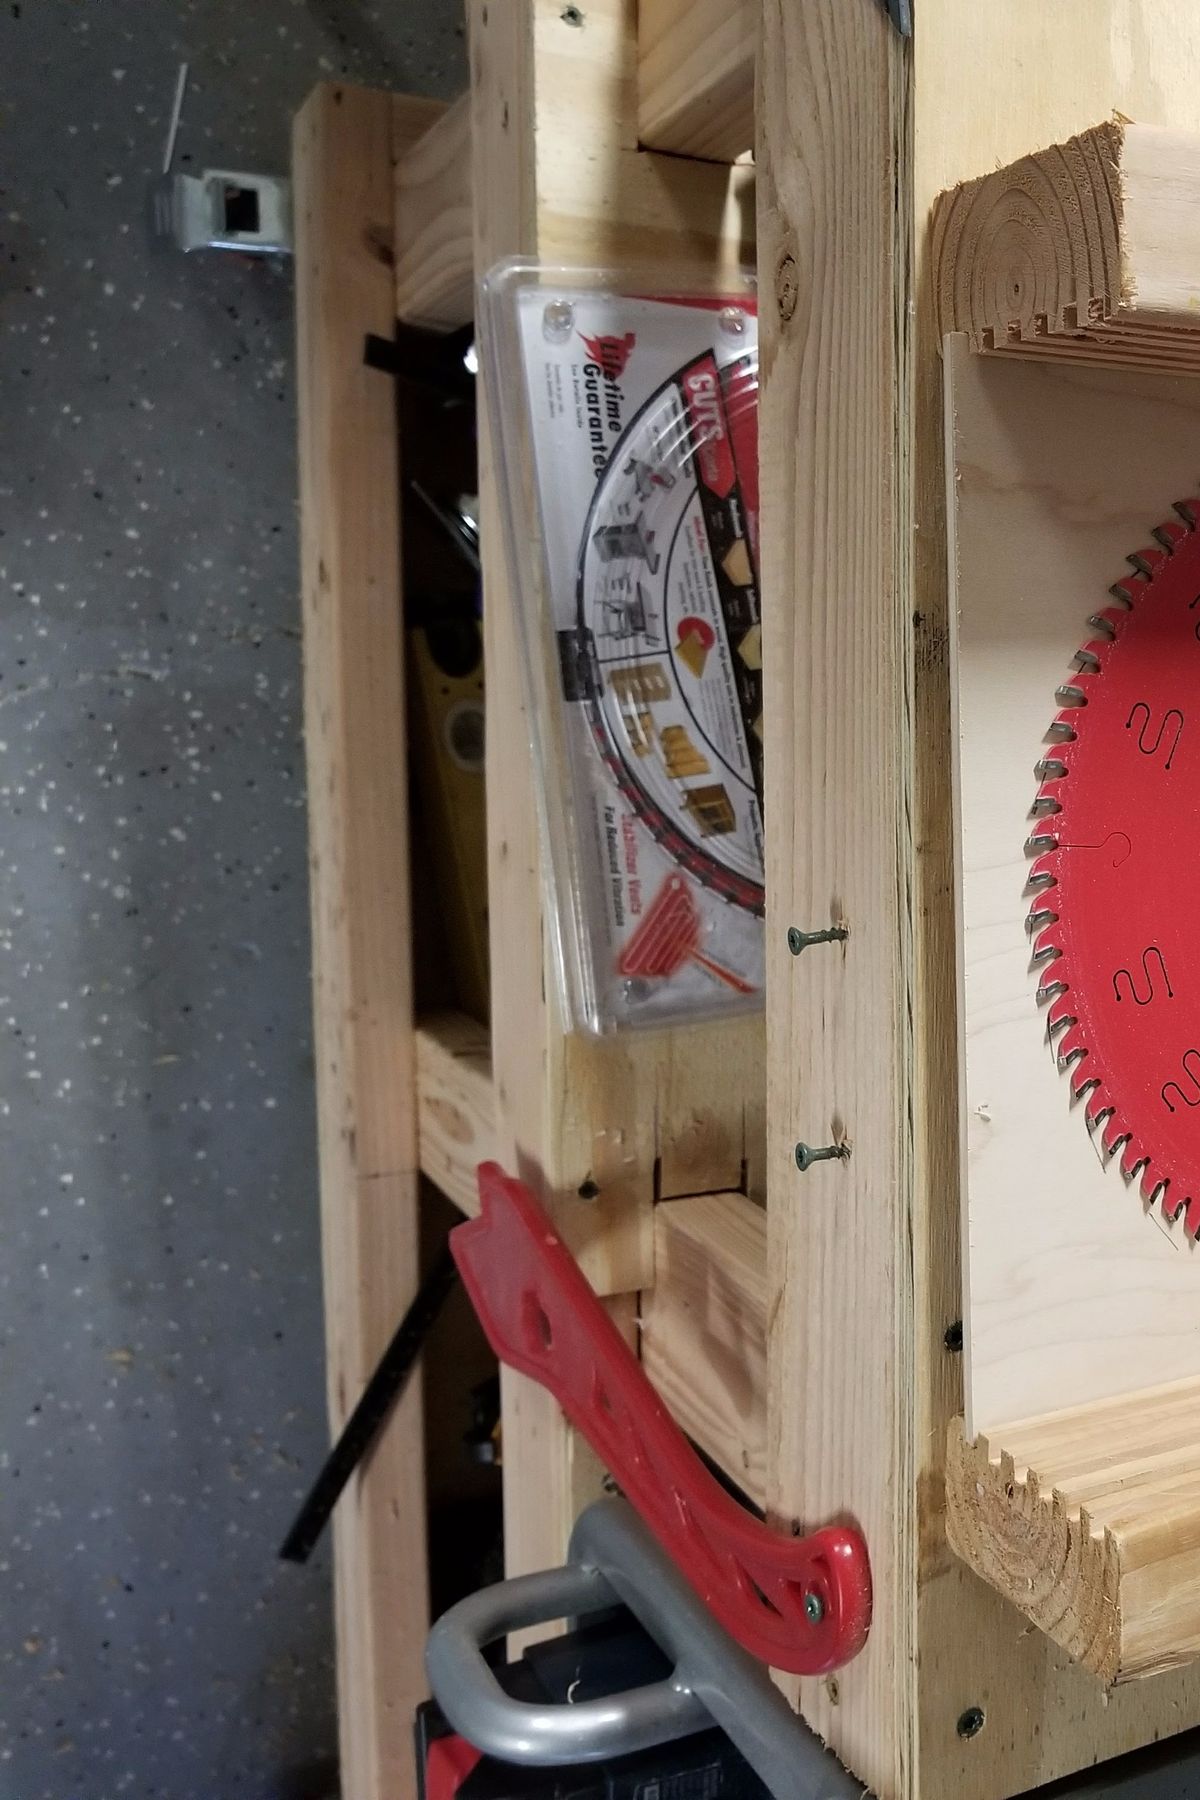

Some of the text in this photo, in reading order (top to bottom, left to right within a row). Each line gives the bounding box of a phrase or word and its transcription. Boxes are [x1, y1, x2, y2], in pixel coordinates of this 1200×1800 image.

[583, 363, 608, 481] Guarantee
[600, 342, 625, 433] Lifetime
[688, 373, 725, 440] CUTS
